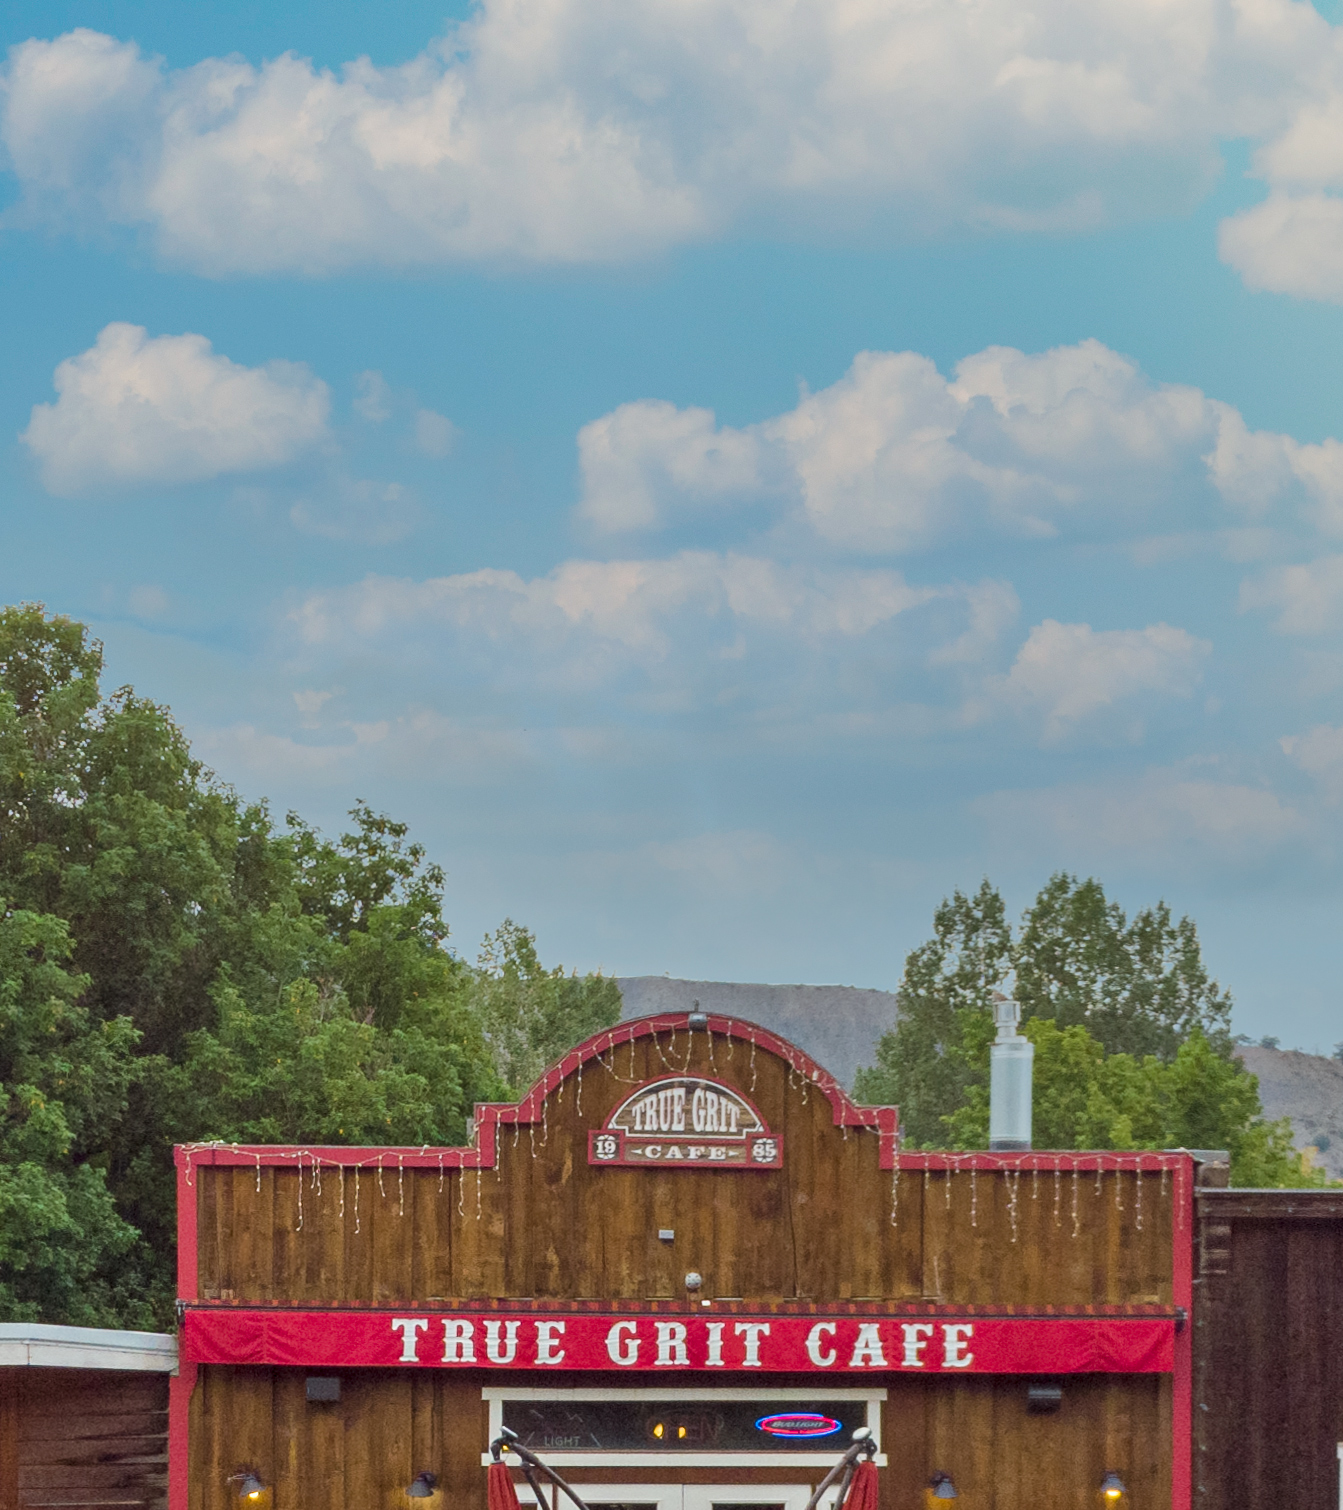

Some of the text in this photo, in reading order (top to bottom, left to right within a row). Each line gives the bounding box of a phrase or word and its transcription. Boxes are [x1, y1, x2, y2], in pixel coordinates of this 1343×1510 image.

[632, 1088, 740, 1133] TRUE GRIT
[596, 1141, 616, 1154] 19
[645, 1145, 726, 1160] CAFE
[753, 1144, 776, 1157] 85
[391, 1318, 974, 1367] TRUE GRIT CAFE
[544, 1435, 581, 1447] LIGHT
